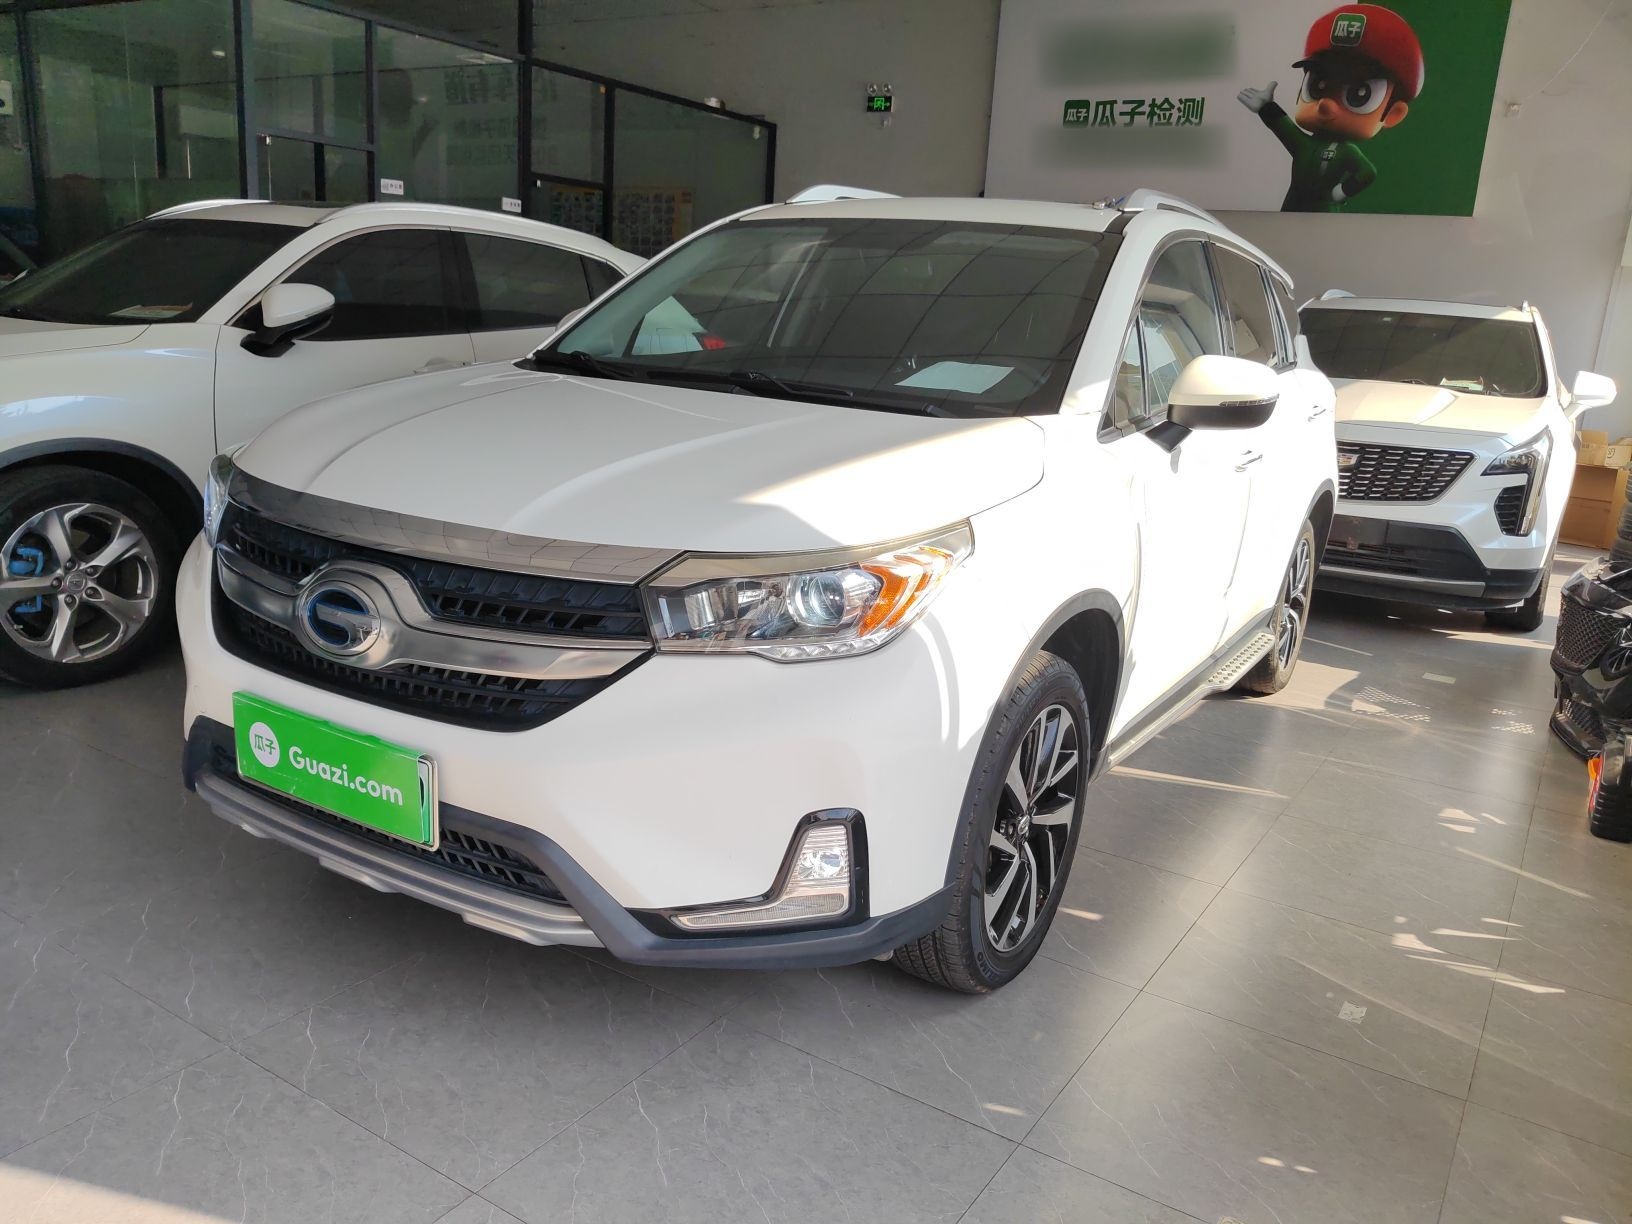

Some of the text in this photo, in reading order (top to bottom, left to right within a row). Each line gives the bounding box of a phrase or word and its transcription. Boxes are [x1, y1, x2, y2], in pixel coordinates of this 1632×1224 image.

[1334, 20, 1362, 38] 瓜子
[1065, 97, 1205, 128] 瓜子 瓜子检测
[254, 733, 276, 755] 瓜子
[289, 746, 403, 805] Guazi.com
